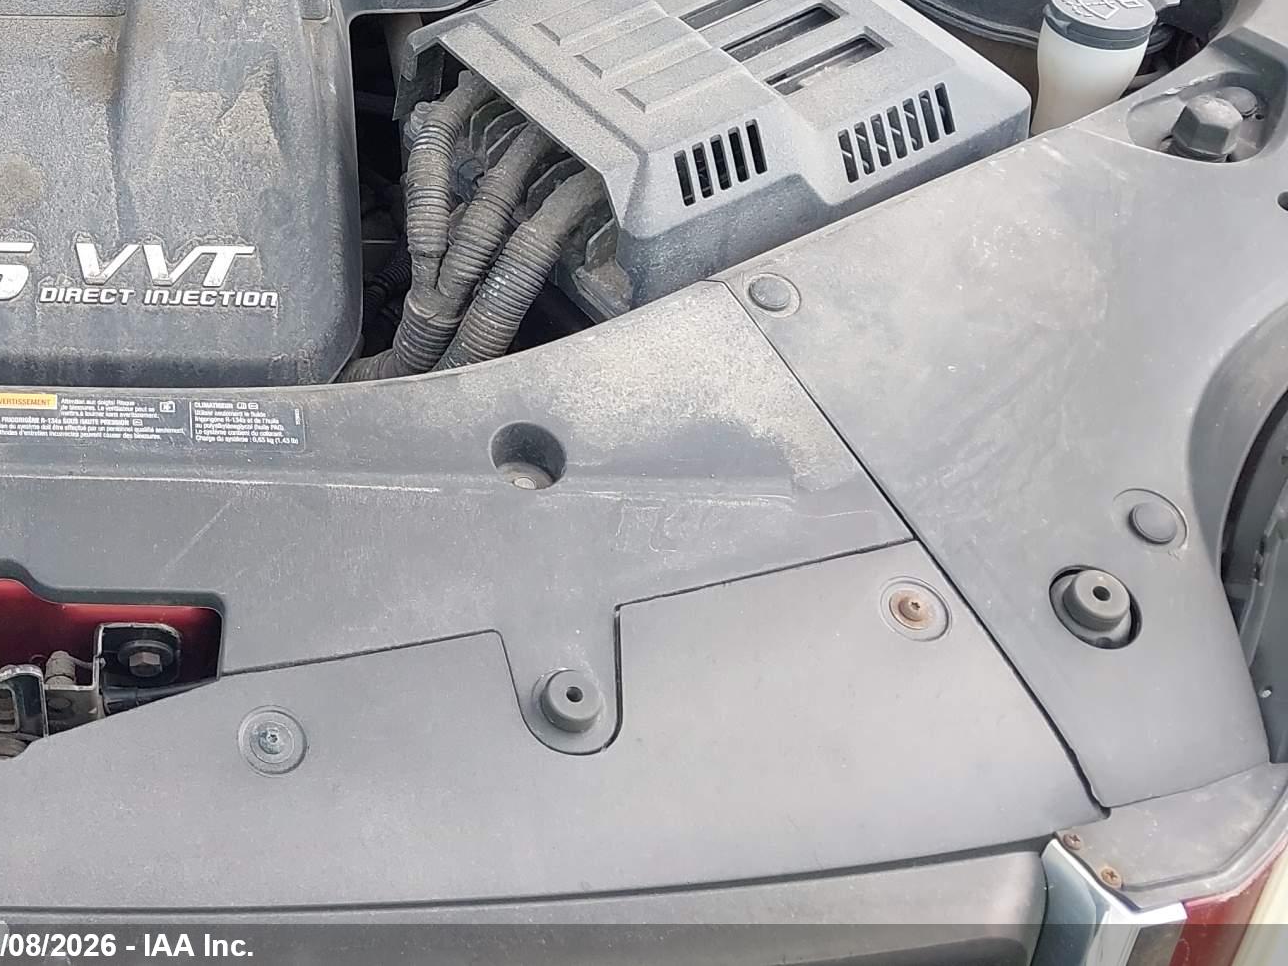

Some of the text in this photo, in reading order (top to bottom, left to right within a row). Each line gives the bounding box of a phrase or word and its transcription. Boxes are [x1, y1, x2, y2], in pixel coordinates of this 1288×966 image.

[76, 242, 256, 287] VVT
[39, 287, 278, 308] DIRECT INJECTION
